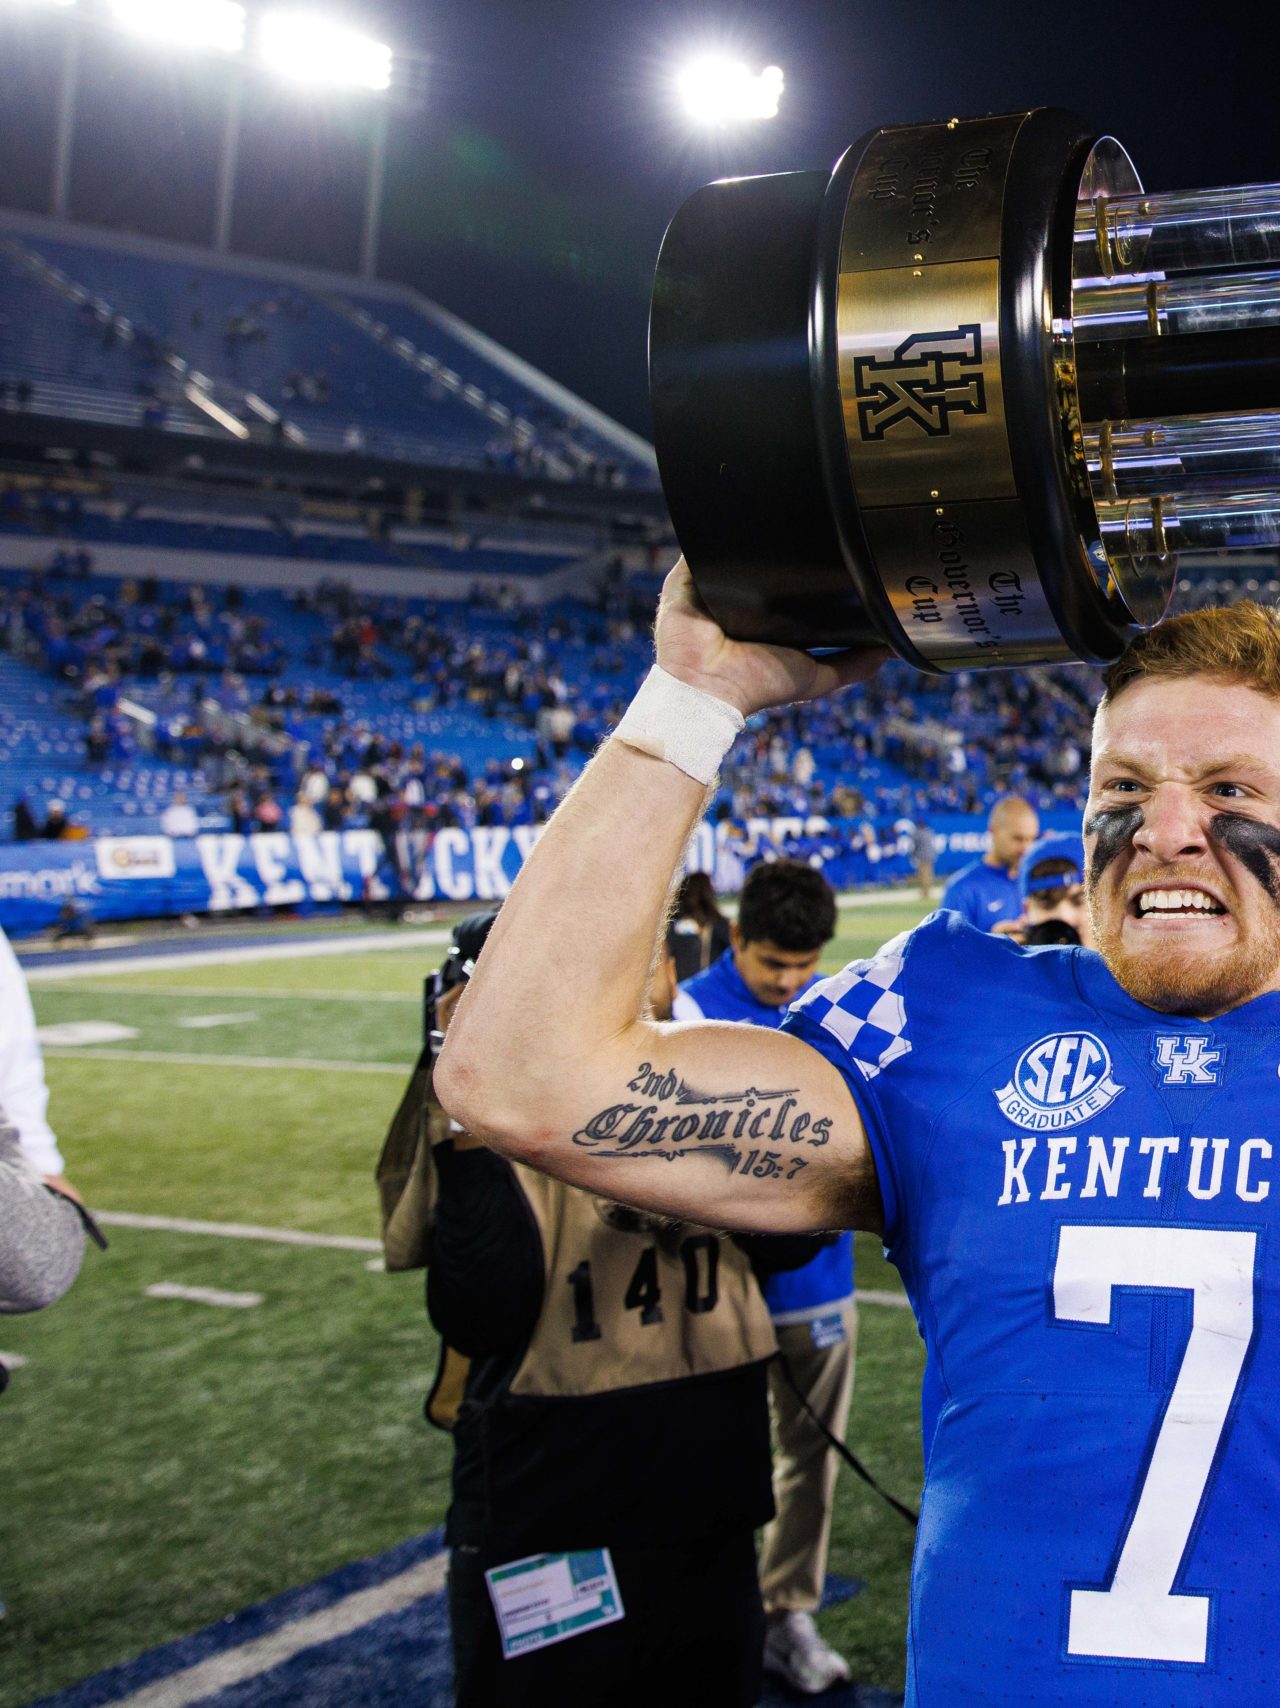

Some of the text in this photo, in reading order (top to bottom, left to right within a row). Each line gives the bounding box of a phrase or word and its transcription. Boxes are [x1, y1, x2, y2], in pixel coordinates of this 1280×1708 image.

[905, 575, 943, 623] Cup
[931, 520, 1002, 648] Governor's
[988, 569, 1026, 616] The
[627, 1061, 678, 1101] 2nd
[1025, 1036, 1105, 1105] SEC
[1154, 1035, 1222, 1086] UK
[572, 1098, 834, 1150] Chronicles
[1006, 1097, 1101, 1131] GRADUATE
[567, 1234, 721, 1344] 140
[1052, 1224, 1258, 1664] 7
